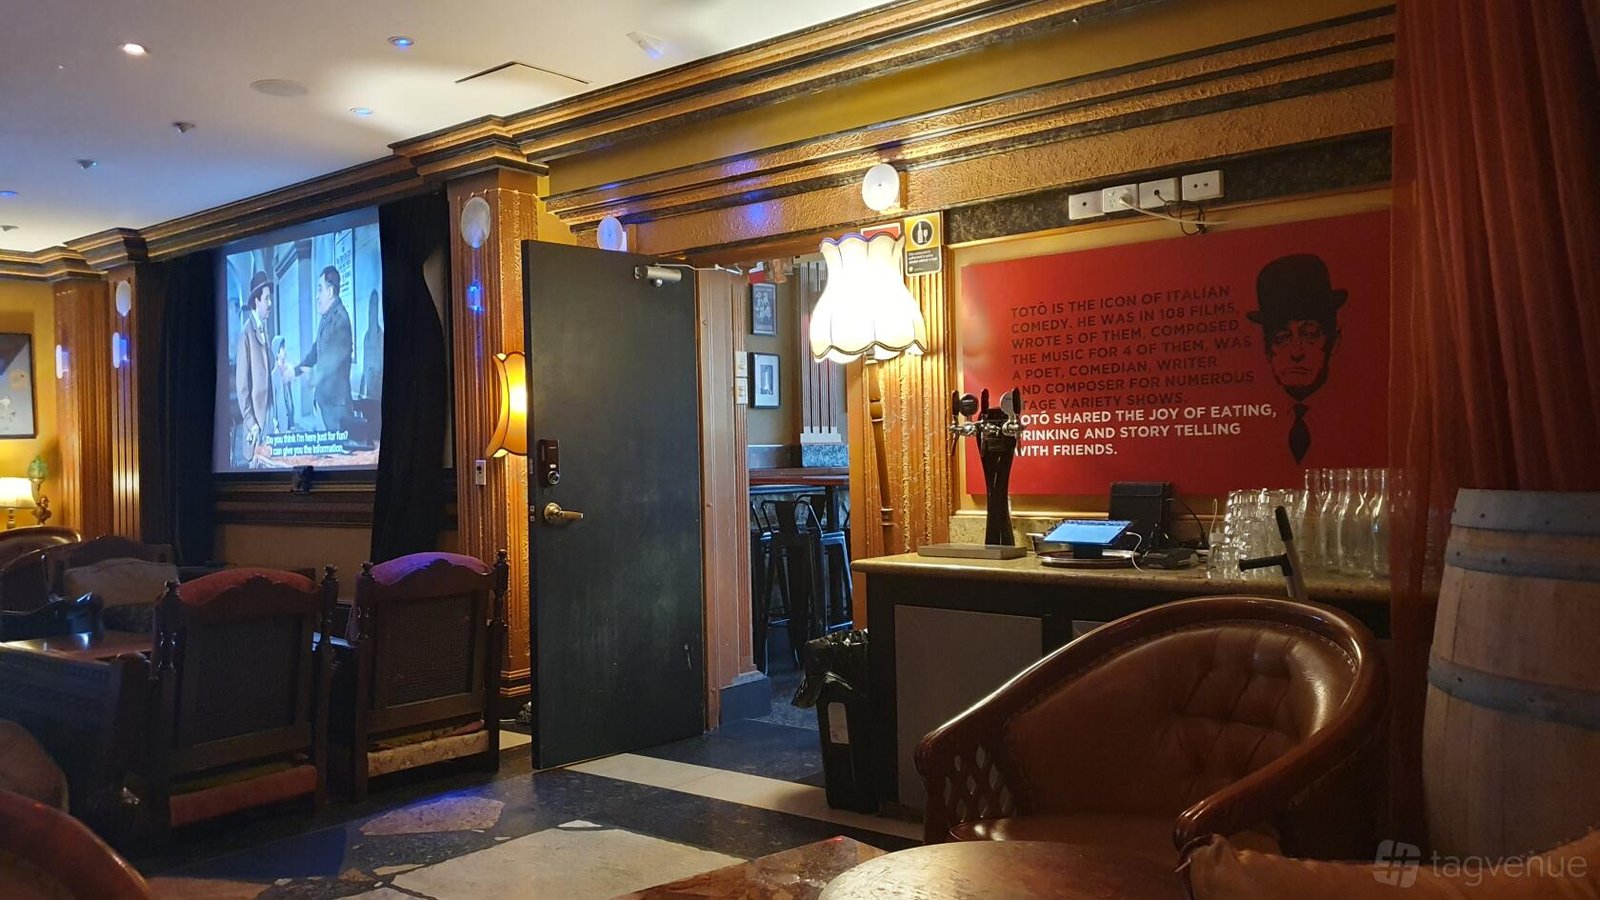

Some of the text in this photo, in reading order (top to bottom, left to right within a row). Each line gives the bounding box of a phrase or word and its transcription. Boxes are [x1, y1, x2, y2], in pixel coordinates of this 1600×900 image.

[1052, 303, 1064, 315] IS
[1068, 300, 1095, 311] THE
[1100, 295, 1136, 309] ICON
[1142, 292, 1162, 304] OF
[1167, 285, 1230, 302] ITALIAN
[1011, 319, 1073, 334] COMEDY.
[1077, 316, 1095, 327] HE
[1101, 312, 1135, 325] WAS
[1140, 310, 1154, 321] IN
[1161, 307, 1185, 320] 108
[1011, 319, 1240, 349] WROTE 5 OF THEM, COMPOSED
[1011, 335, 1253, 364] THE MUSIC FOR 4 OF THEM, WAS
[1012, 356, 1217, 380] A POET, COMEDIAN, WRITER
[1021, 370, 1256, 395] ND COMPOSER FOR NUMEROUS
[1022, 399, 1057, 411] TAGE
[1061, 396, 1121, 409] VARIETY
[1054, 411, 1111, 424] SHARED
[1115, 409, 1144, 422] THE
[1149, 407, 1179, 421] JOY
[1184, 406, 1206, 419] OF
[1211, 404, 1277, 418] EATING,
[274, 436, 283, 446] you
[283, 433, 296, 443] think
[305, 432, 316, 442] here
[316, 432, 327, 443] just
[336, 430, 349, 440] fun?
[1021, 422, 1241, 441] RINKING AND STORY TELLING
[273, 447, 283, 456] can
[283, 445, 293, 457] give
[293, 447, 304, 457] you
[304, 444, 312, 454] the
[1054, 444, 1118, 456] FRIENDS.
